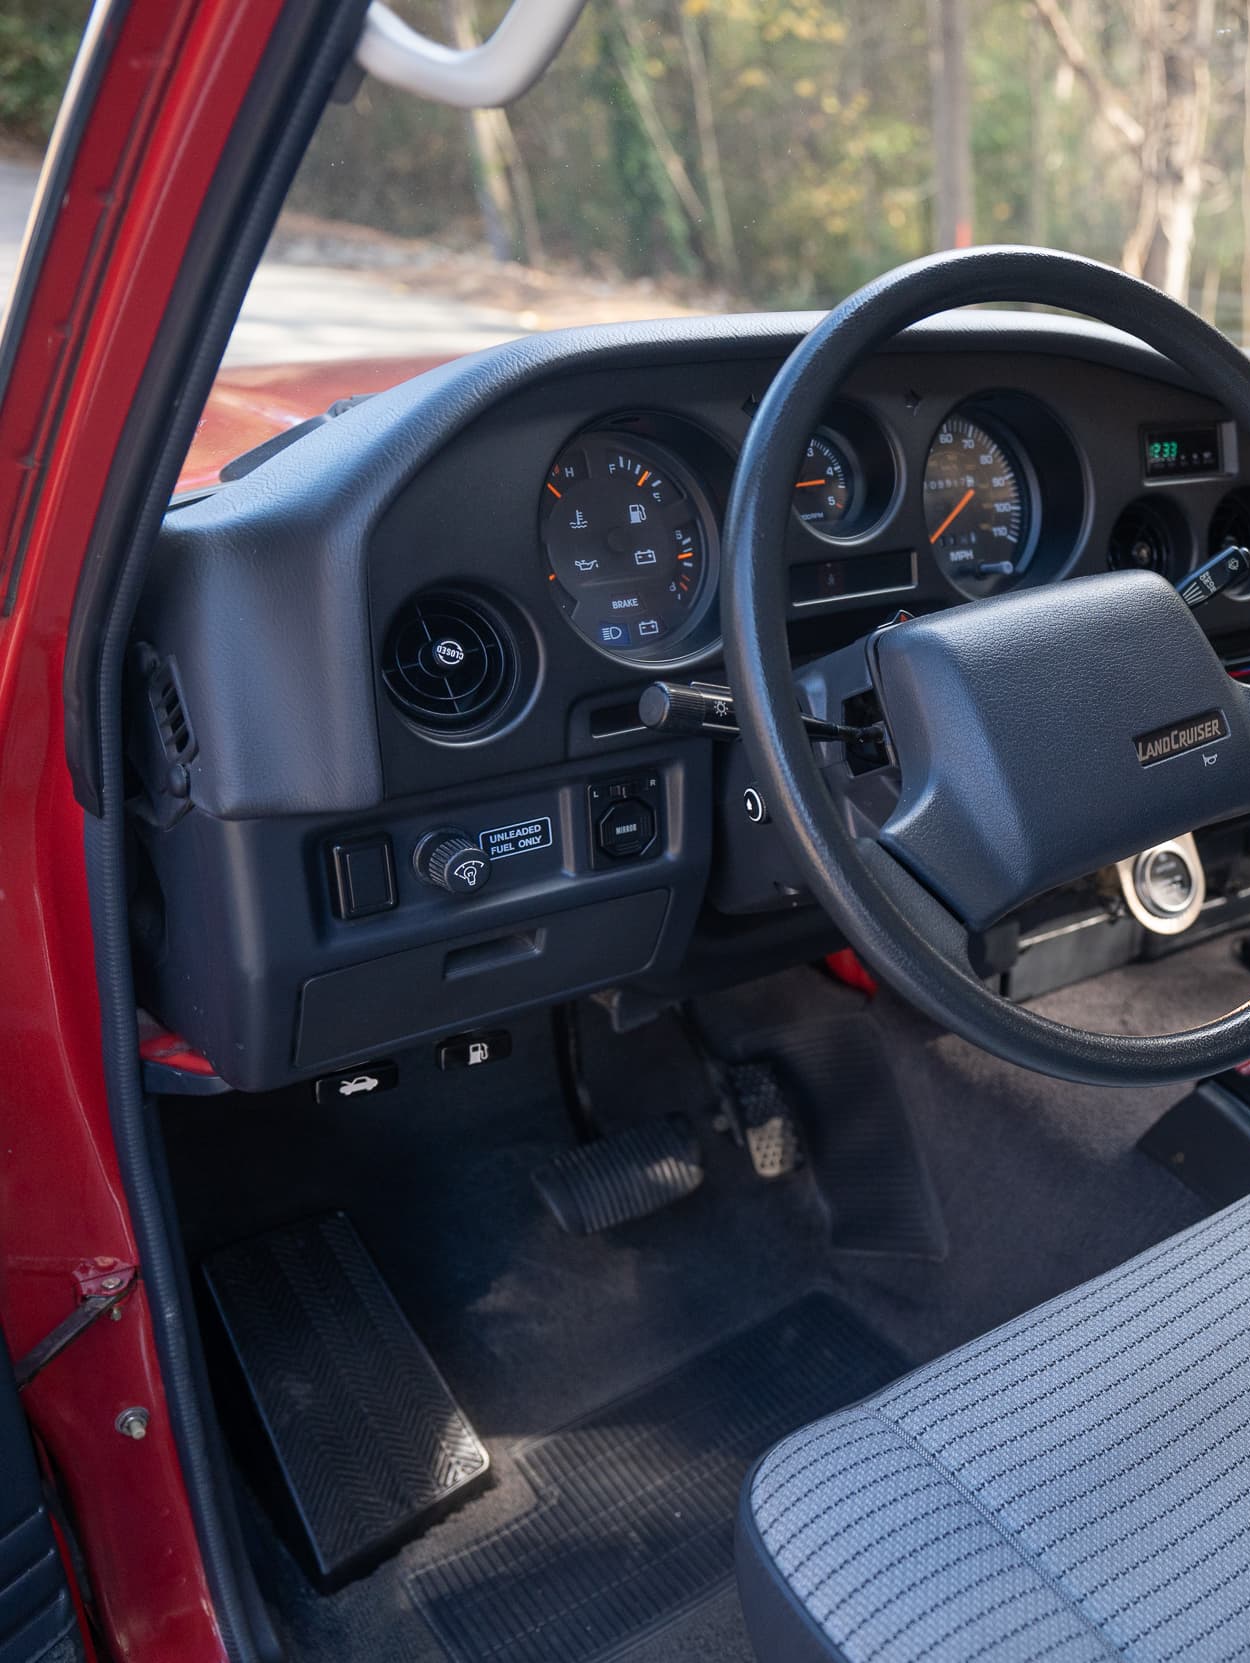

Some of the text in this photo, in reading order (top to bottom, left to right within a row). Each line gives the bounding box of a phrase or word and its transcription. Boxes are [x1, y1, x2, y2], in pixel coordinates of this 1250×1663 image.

[806, 447, 814, 457] 3
[564, 466, 575, 478] H
[608, 463, 616, 474] F
[826, 466, 834, 476] 4
[827, 495, 836, 506] 5
[950, 549, 974, 562] MPH
[612, 598, 639, 610] BRAKE
[436, 645, 464, 661] CLOSED
[489, 824, 542, 844] UNLEADED
[490, 835, 542, 856] FUEL ONLY
